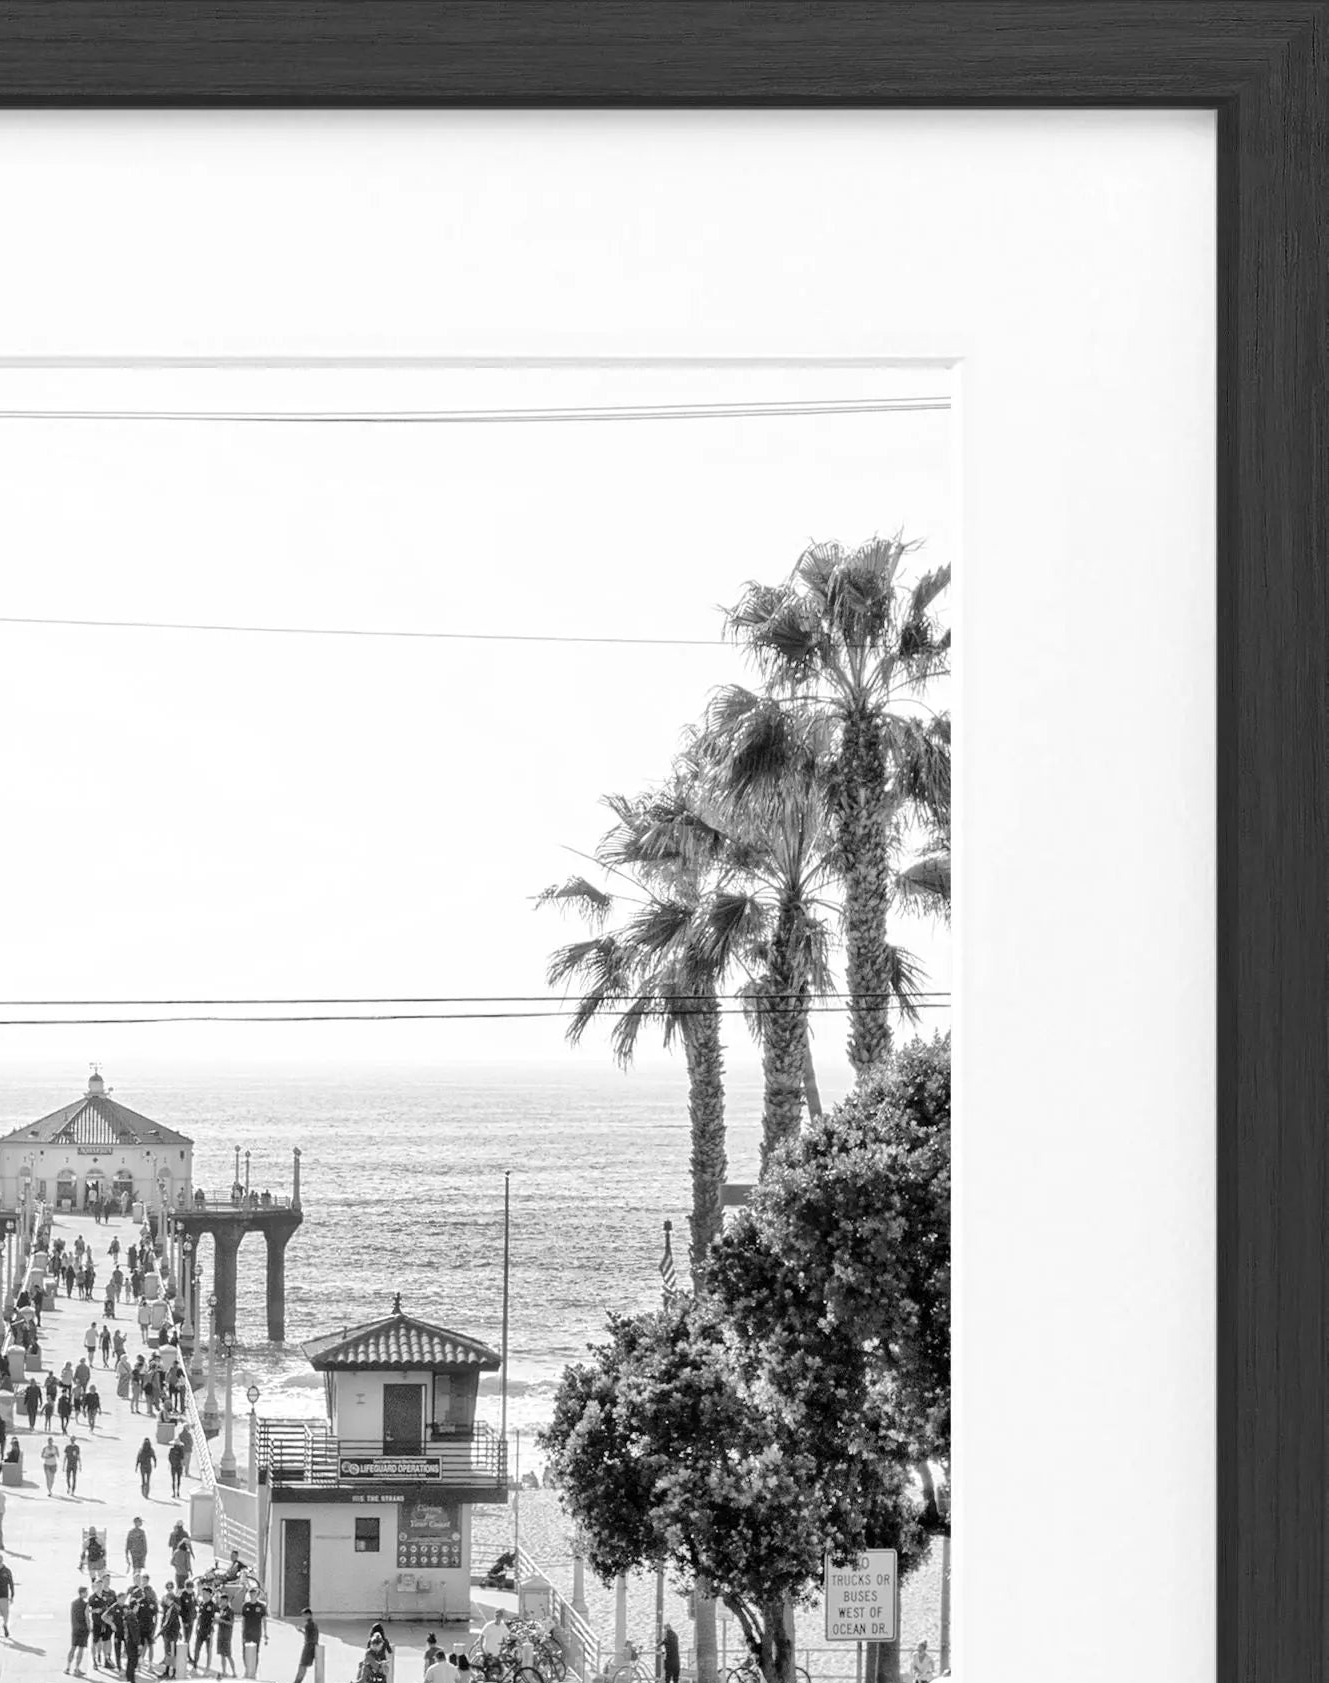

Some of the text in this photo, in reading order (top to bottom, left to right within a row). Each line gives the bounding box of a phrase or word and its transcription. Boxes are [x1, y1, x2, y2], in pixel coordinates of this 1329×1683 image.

[360, 1463, 439, 1474] LIFEGUARD OPERATIONS
[832, 1574, 891, 1586] TRUCKS OR
[843, 1590, 878, 1602] BUSES
[838, 1606, 883, 1618] WEST OF
[832, 1622, 888, 1635] OCEAN DR.
